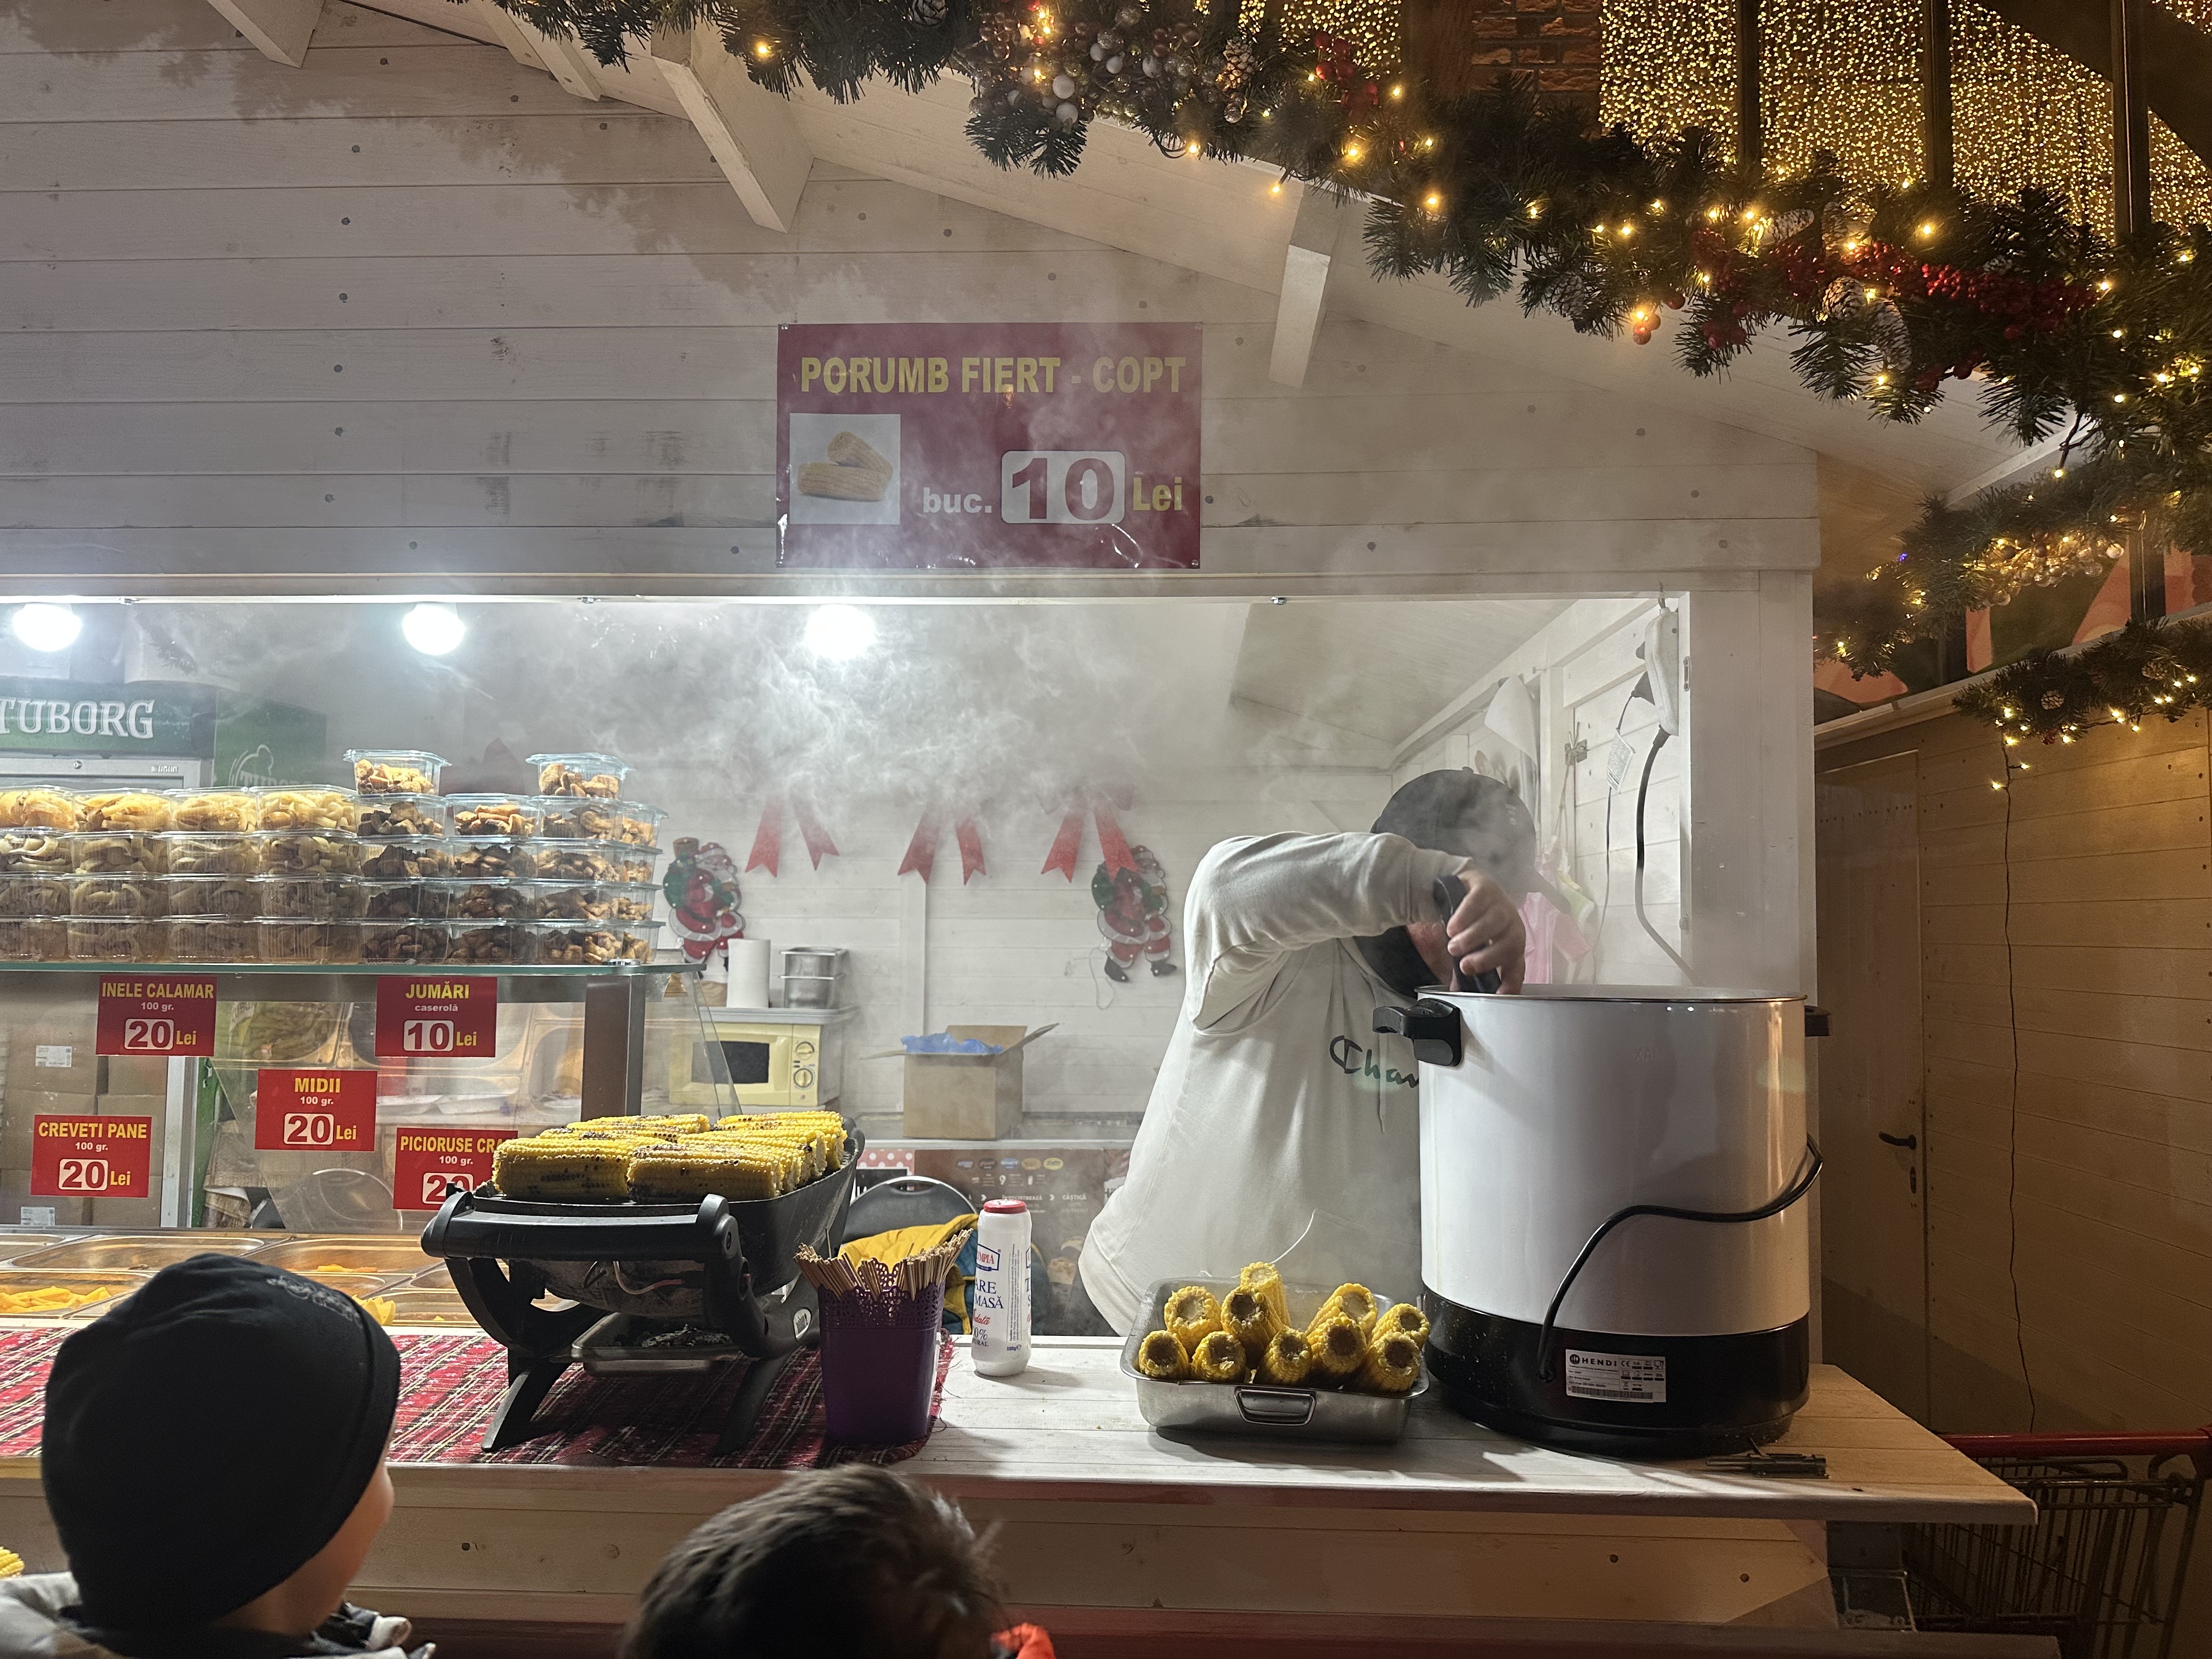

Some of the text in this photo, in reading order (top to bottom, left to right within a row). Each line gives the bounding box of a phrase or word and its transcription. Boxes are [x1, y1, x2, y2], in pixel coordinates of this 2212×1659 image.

[801, 357, 949, 394] PORUMB
[962, 357, 1060, 393] FIERT
[1092, 357, 1186, 394] COPT
[923, 458, 1183, 521] buc. 10 Lei
[0, 697, 155, 739] TUBORG
[102, 983, 214, 999] INELE CALAMAR
[405, 981, 470, 999] JUMĂRI
[141, 1002, 174, 1012] 100 gr.
[414, 1003, 459, 1012] caserolă
[127, 1020, 197, 1048] 20 Lei
[407, 1022, 477, 1050] 10 Lei
[294, 1077, 341, 1093] MIDII
[300, 1097, 334, 1107] 100 gr.
[38, 1122, 148, 1139] CREVETI PANE
[286, 1115, 357, 1143] 20 Lei
[75, 1142, 109, 1152] 100 gr.
[400, 1136, 473, 1153] PICIORUSE
[439, 1155, 473, 1166] 100 gr.
[61, 1160, 131, 1188] 20 Lei
[977, 1251, 995, 1265] MPIA
[975, 1278, 997, 1294] ARE
[975, 1294, 1004, 1309] MASĂ
[1582, 1357, 1617, 1367] HENDI
